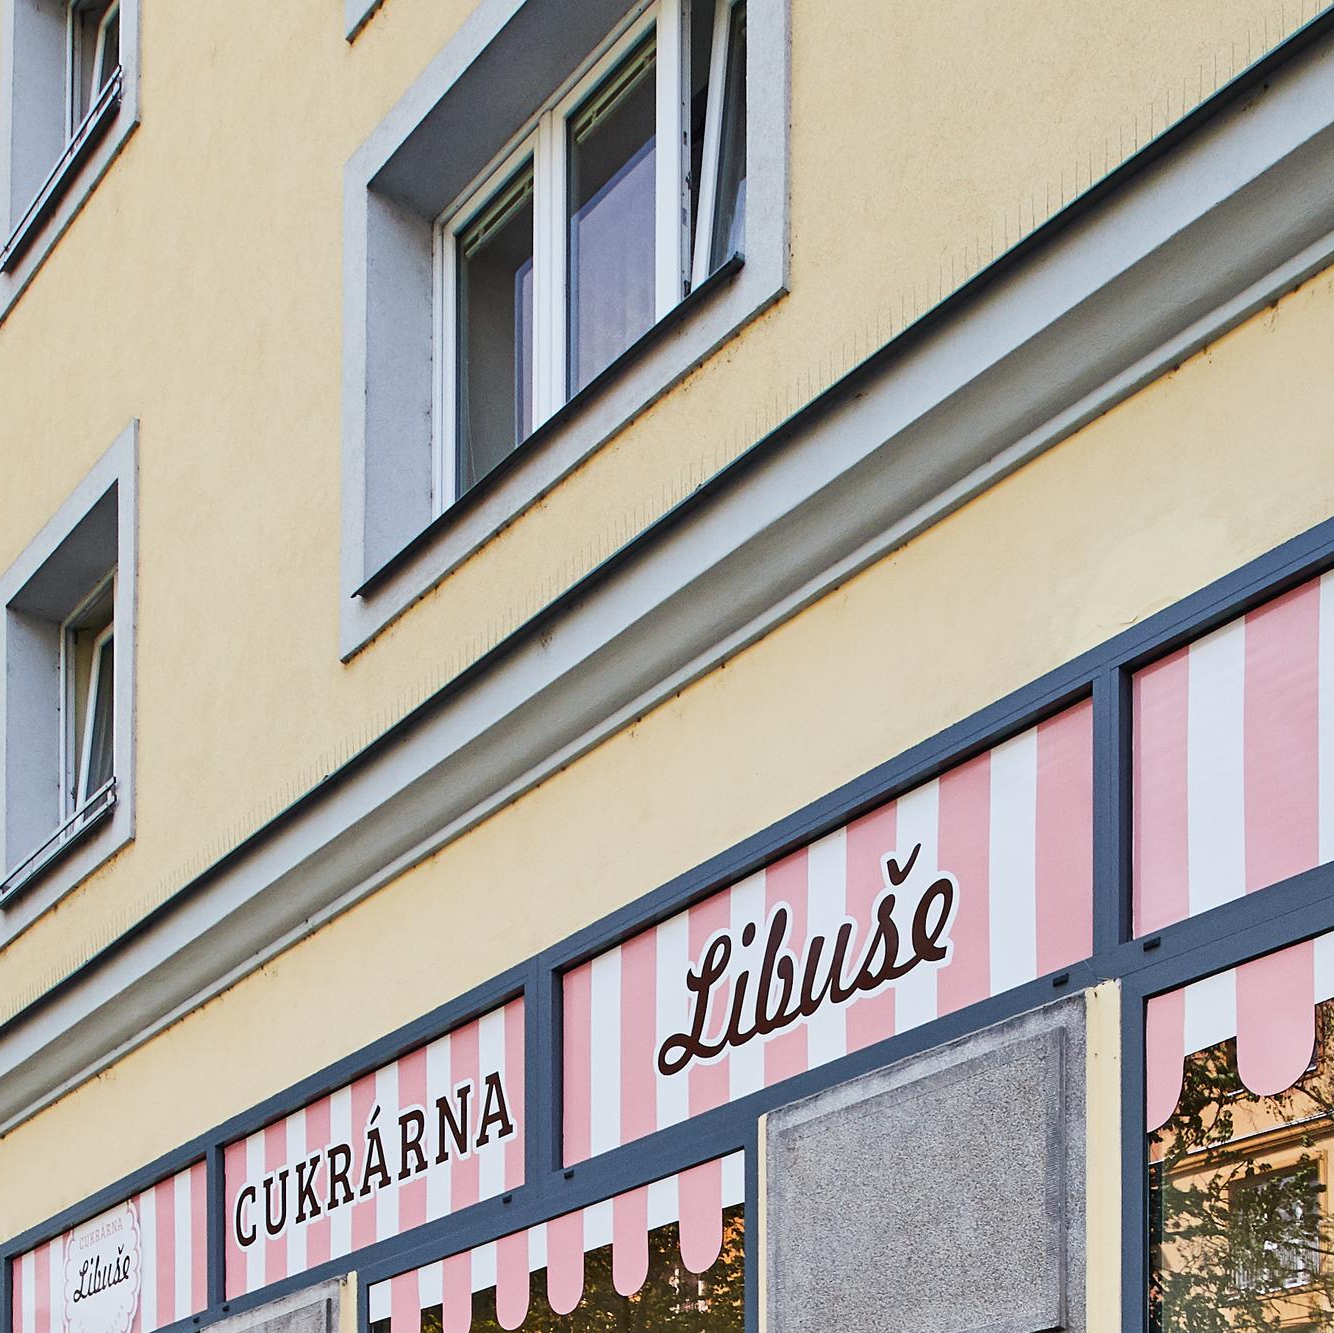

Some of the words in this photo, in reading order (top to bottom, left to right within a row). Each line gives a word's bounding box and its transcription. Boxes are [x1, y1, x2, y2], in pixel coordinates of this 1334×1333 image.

[657, 843, 955, 1077] Libuše
[234, 1070, 515, 1248] CUKRÁRNA
[73, 1243, 131, 1303] Libuše
